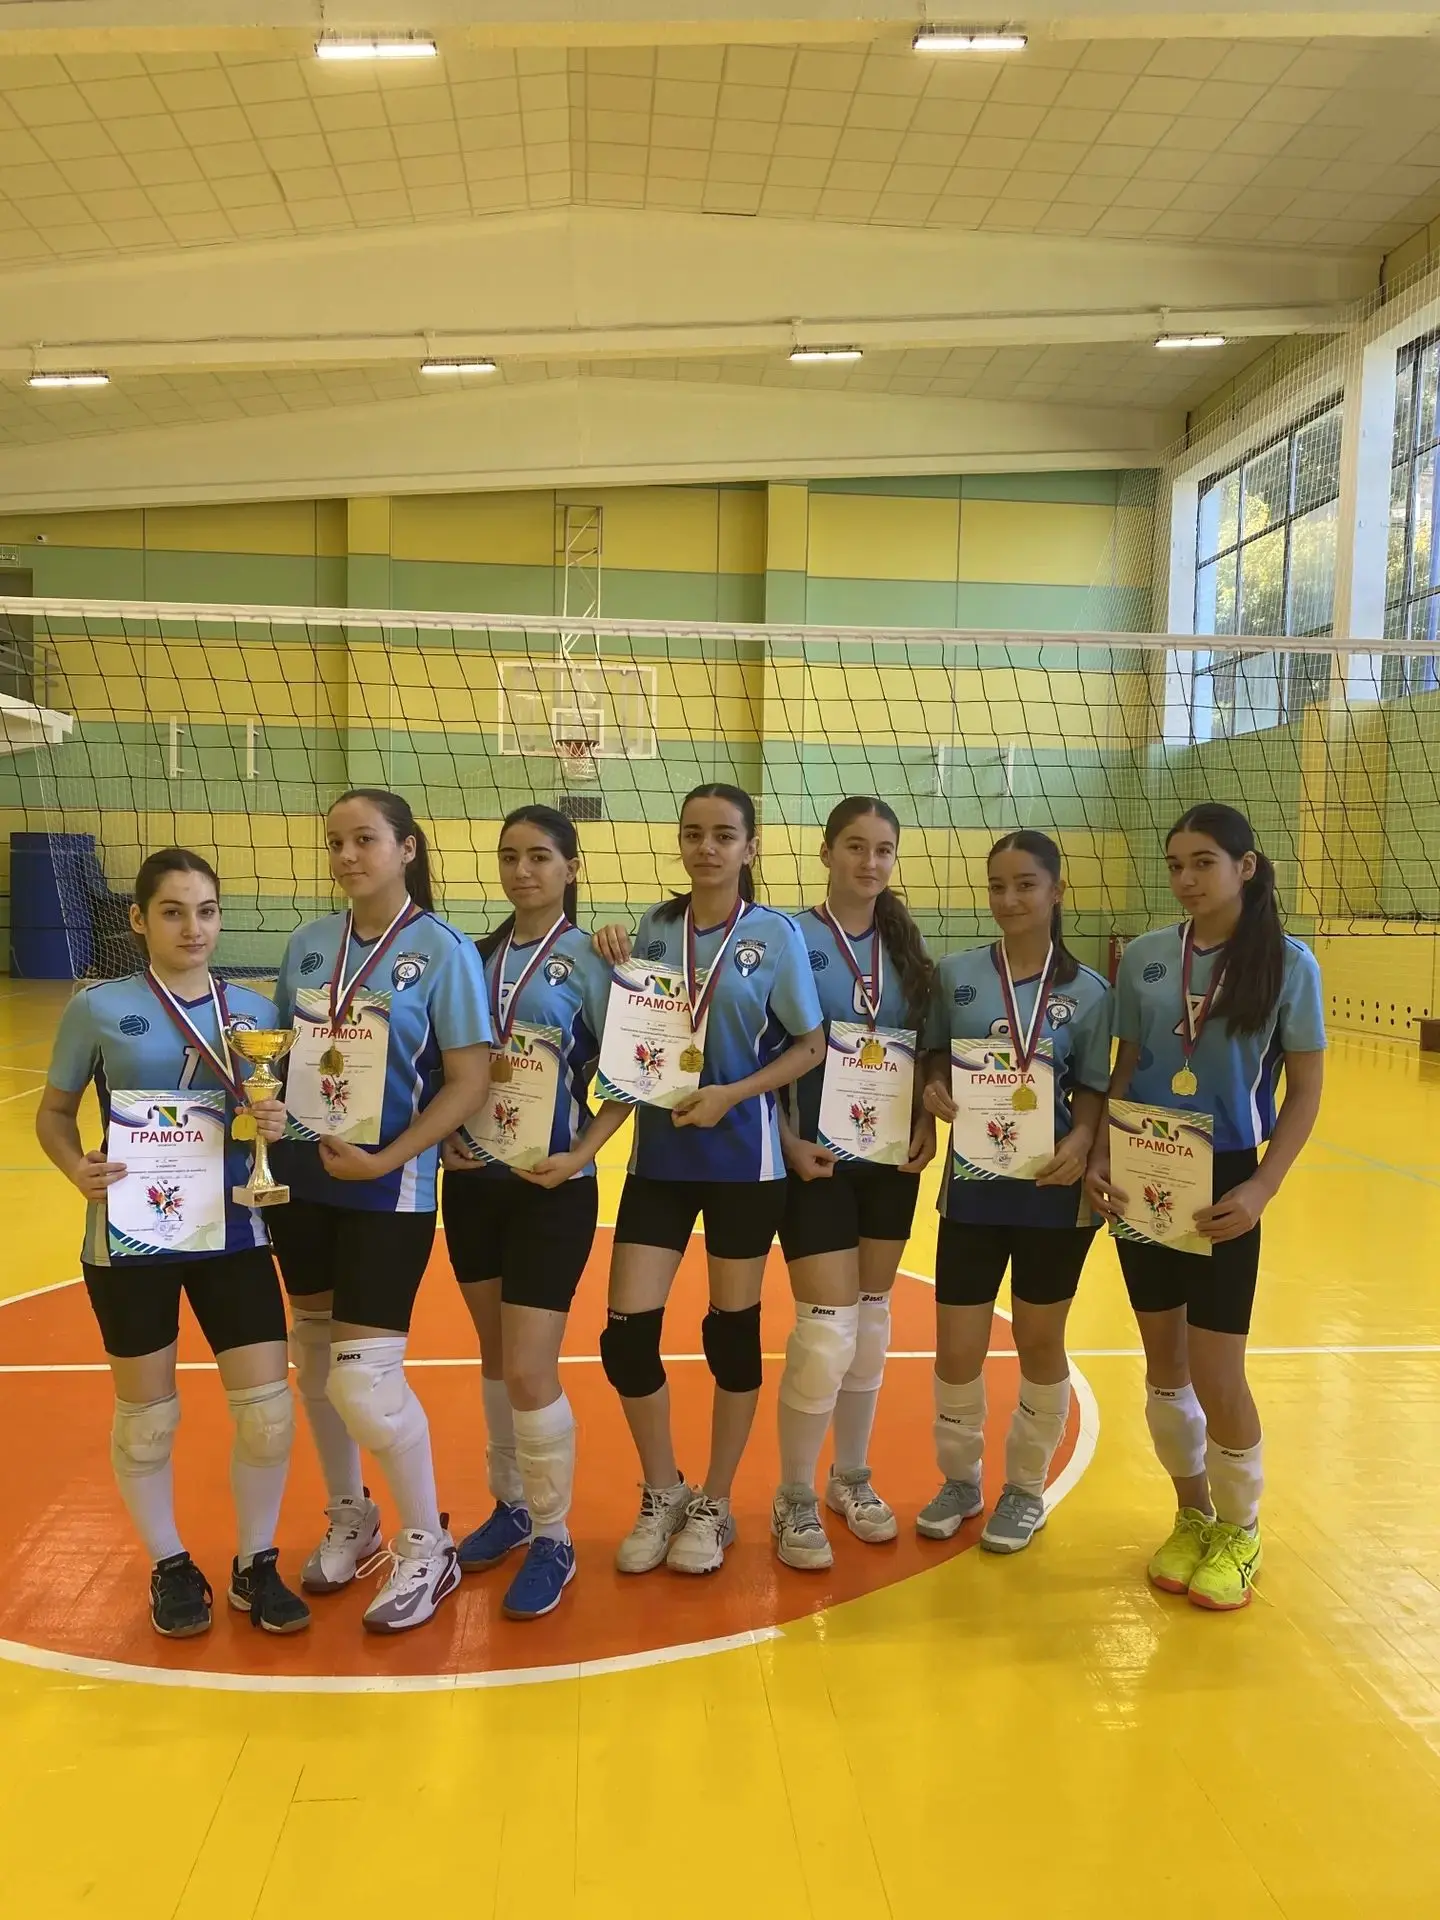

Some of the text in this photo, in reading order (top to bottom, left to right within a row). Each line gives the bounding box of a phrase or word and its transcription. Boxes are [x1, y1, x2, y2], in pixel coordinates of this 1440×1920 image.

[628, 994, 691, 1013] ГРАМОТА
[312, 1027, 372, 1040] ГРАМОТА
[971, 1073, 1035, 1084] ГРАМОТА
[131, 1130, 204, 1143] ГРАМОТА
[1129, 1136, 1194, 1158] ГРАМОТА
